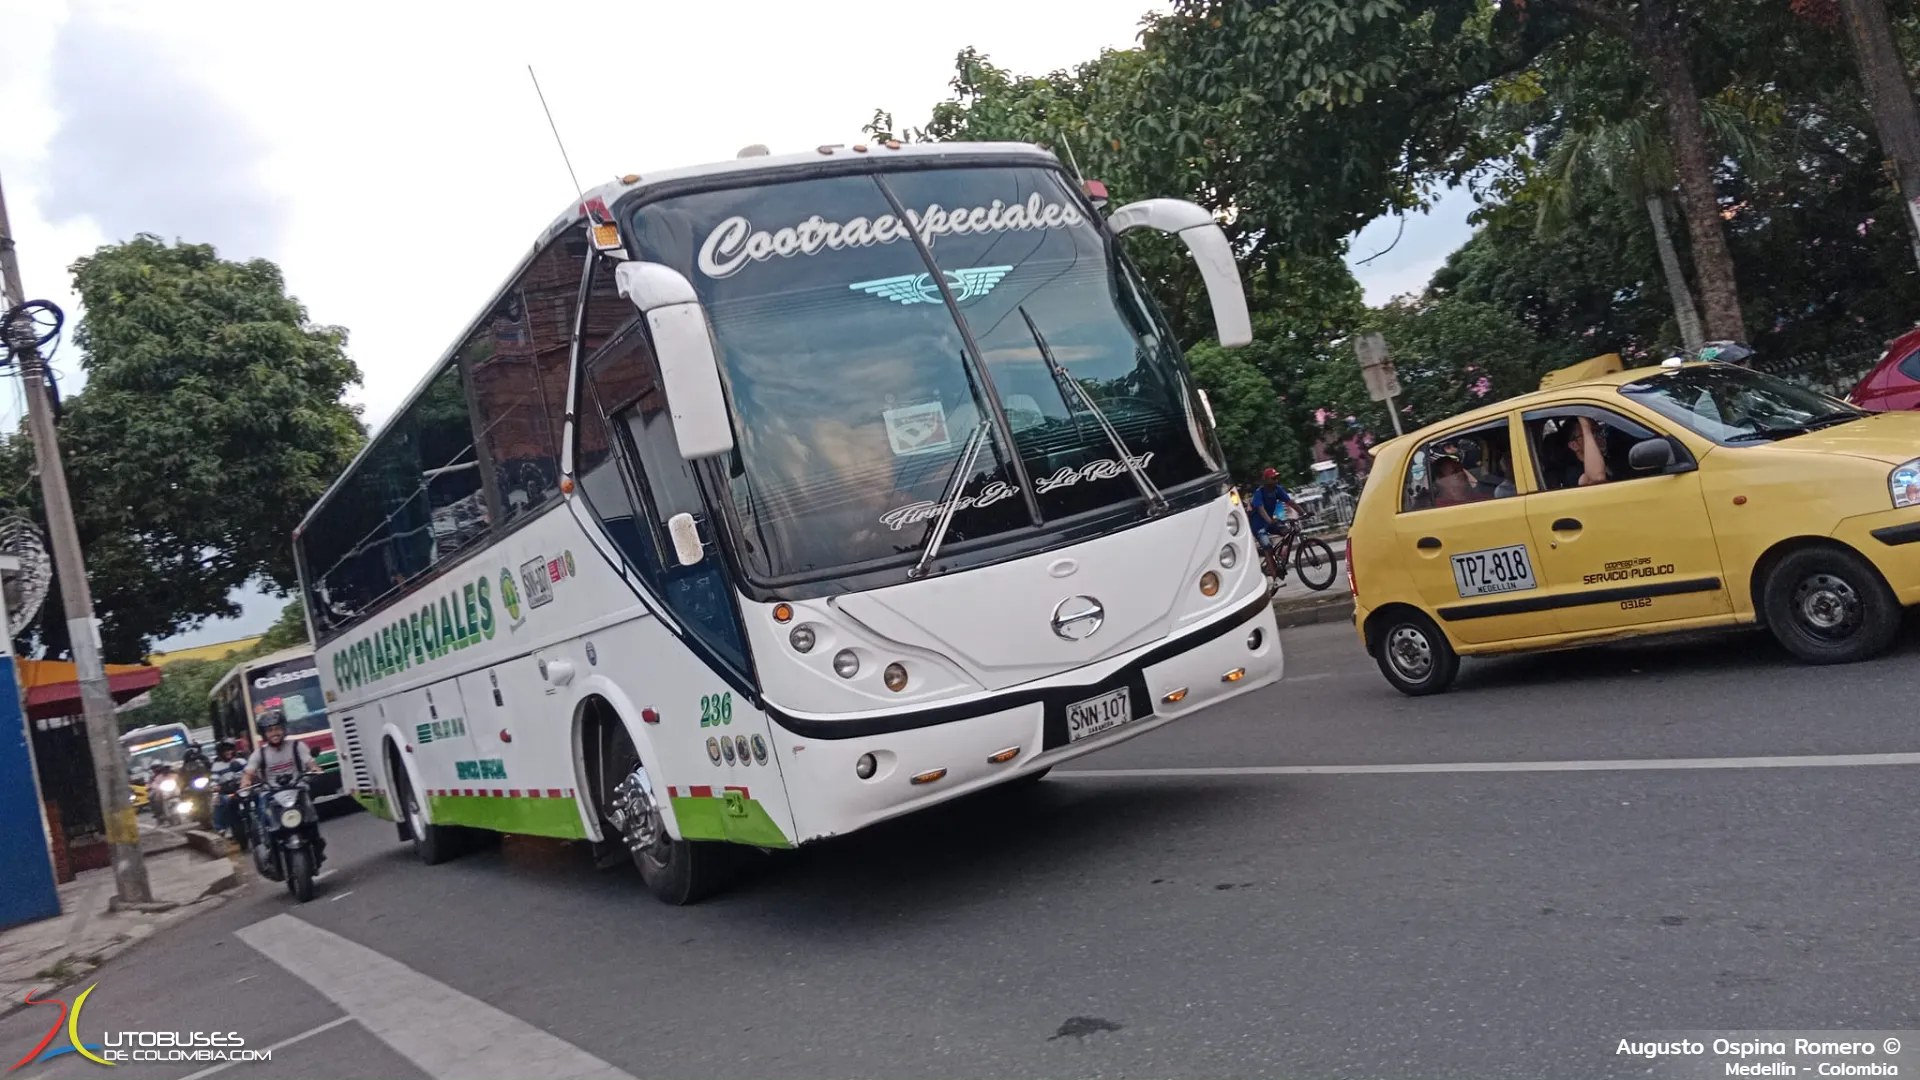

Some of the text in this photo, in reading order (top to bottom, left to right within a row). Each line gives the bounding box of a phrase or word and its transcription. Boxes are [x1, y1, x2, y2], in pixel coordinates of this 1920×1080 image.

[698, 192, 1085, 278] Cootraespeciales
[1036, 466, 1081, 493] La
[1583, 570, 1628, 585] SERVICIO
[1620, 598, 1652, 610] 03162
[333, 576, 496, 692] COOTRAESPECIALES
[700, 691, 732, 728] 236
